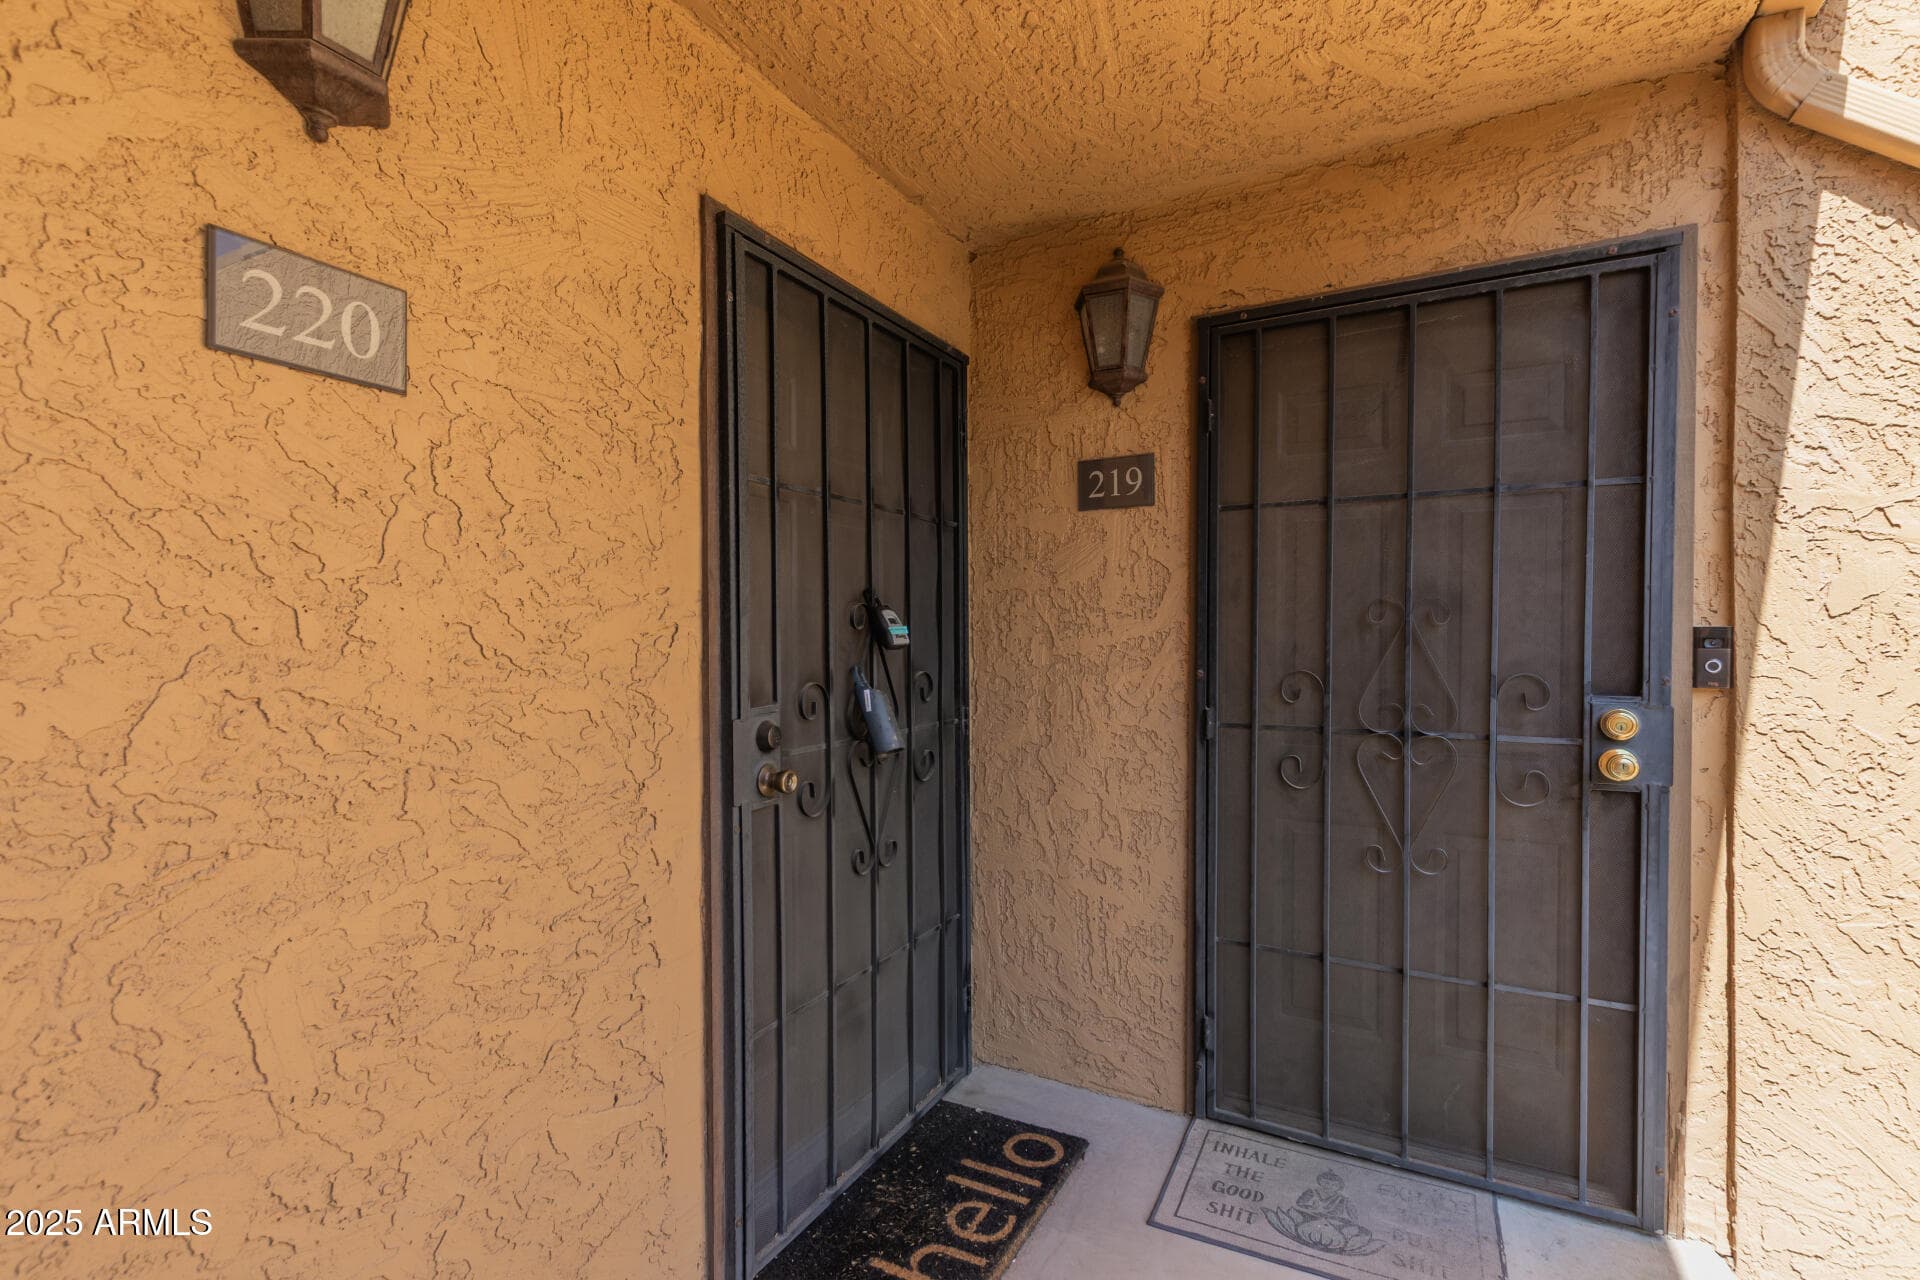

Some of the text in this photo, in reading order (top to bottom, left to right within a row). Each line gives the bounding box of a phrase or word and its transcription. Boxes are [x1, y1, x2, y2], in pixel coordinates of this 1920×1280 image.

[239, 269, 380, 359] 220
[1088, 466, 1143, 498] 219
[1213, 1140, 1287, 1169] INHALE
[1224, 1162, 1265, 1182] THE
[869, 1132, 1065, 1280] hello
[1211, 1180, 1265, 1202] GOOD
